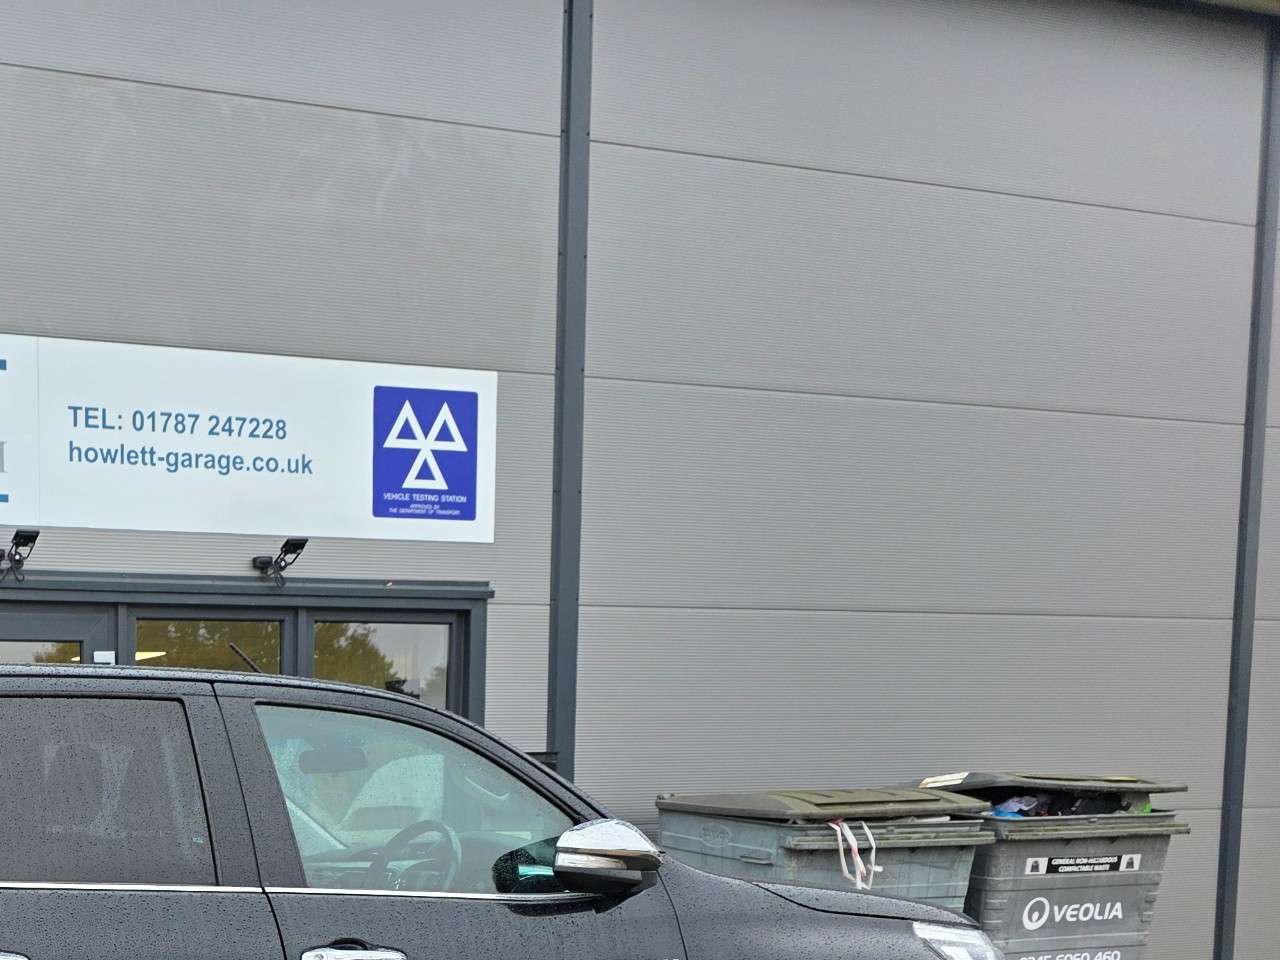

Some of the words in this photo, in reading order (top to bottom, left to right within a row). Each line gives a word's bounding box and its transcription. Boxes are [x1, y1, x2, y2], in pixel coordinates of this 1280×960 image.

[68, 405, 122, 431] TEL:
[132, 410, 200, 435] 01787
[208, 414, 287, 440] 247228
[68, 440, 313, 476] howlett-garage.co.uk
[383, 493, 410, 501] VEHICLE
[412, 494, 439, 502] TESTING
[441, 494, 467, 503] STATION
[1053, 902, 1123, 922] VEOLIA
